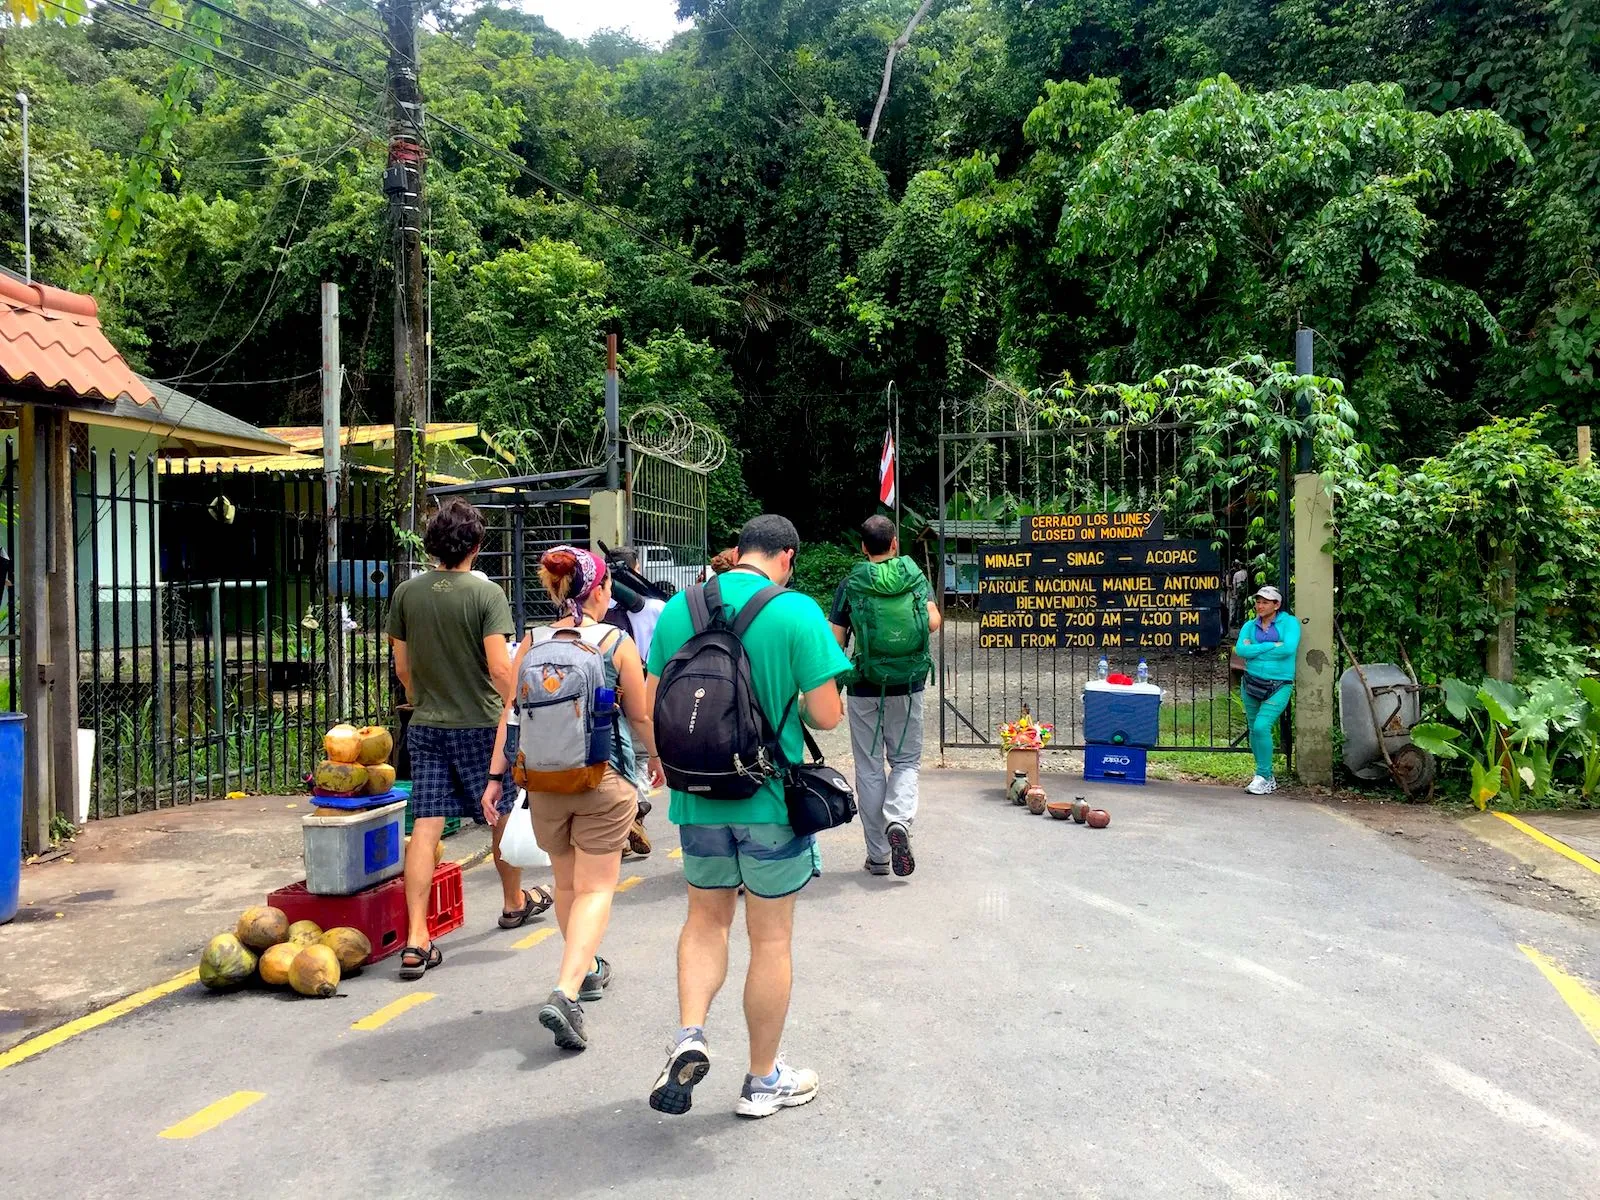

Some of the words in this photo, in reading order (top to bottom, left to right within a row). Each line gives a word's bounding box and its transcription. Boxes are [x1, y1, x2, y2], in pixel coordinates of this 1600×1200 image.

[1031, 514, 1082, 528] CERRADO
[1087, 513, 1108, 526] LOS
[1113, 512, 1151, 525] LUNES
[1031, 528, 1075, 541] CLOSED
[1080, 527, 1095, 540] ON
[1100, 526, 1145, 539] MONDAY
[985, 552, 1032, 568] MINAET
[1066, 551, 1105, 566] SINAC
[1145, 549, 1197, 564] ACOPAC
[979, 579, 1029, 594] PARQUE
[1035, 578, 1097, 593] NACIONAL
[1102, 577, 1157, 591] MANUEL
[1163, 575, 1219, 590] ANTONIO
[1016, 595, 1097, 609] BIENVENIDOS
[1124, 593, 1193, 608] WELCOME
[980, 613, 1034, 628] ABIERTO
[1040, 612, 1057, 628] DE
[1065, 612, 1095, 627] 7:00
[1101, 612, 1121, 626] AM
[1140, 611, 1172, 626] 4:00
[1180, 611, 1200, 625] PM
[980, 634, 1013, 648] OPEN
[1021, 633, 1057, 647] FROM
[1065, 633, 1095, 648] 7:00
[1101, 633, 1121, 647] AM
[1140, 632, 1172, 647] 4:00
[1180, 632, 1200, 647] PM
